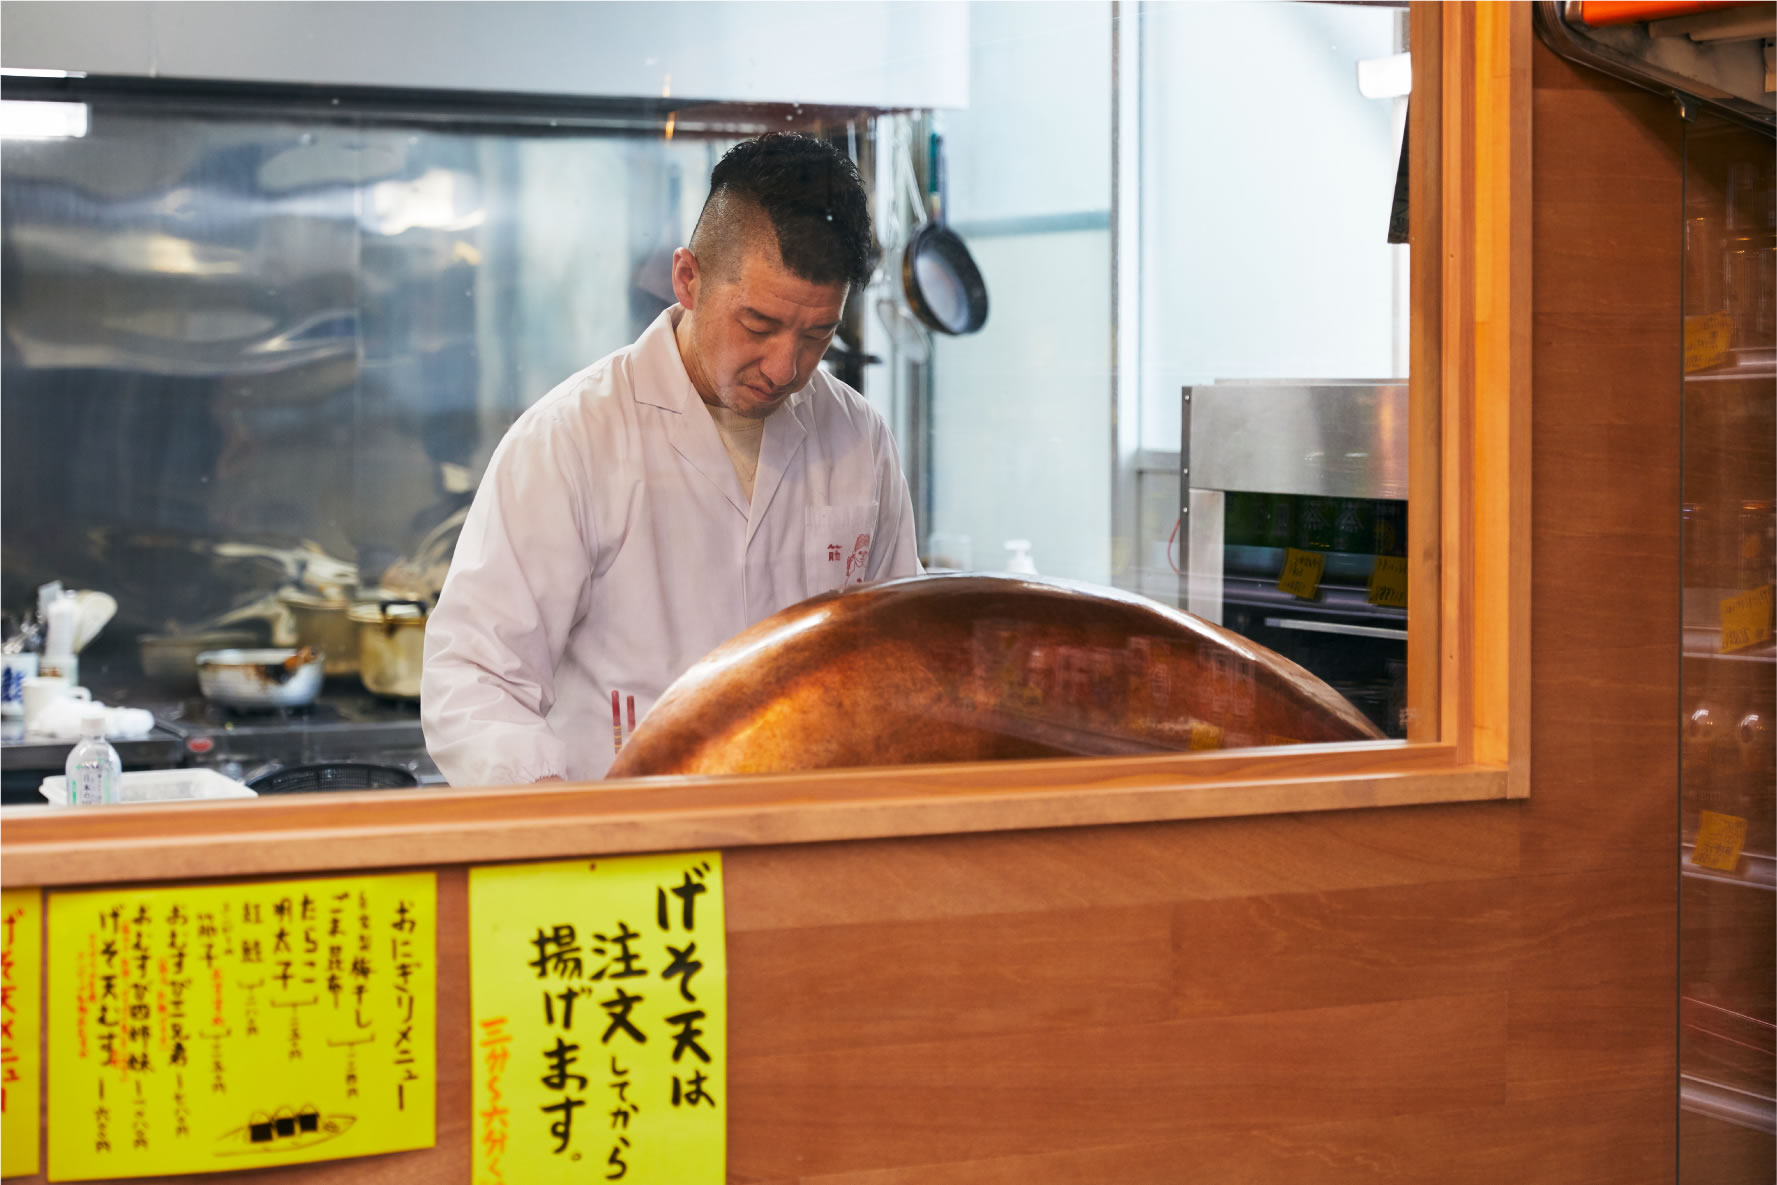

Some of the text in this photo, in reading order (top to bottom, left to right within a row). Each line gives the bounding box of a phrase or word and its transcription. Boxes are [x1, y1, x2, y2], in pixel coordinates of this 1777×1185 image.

[241, 902, 264, 964] 紅鮭
[272, 903, 294, 991] 明太子
[300, 895, 318, 984] たらこ
[326, 892, 350, 1009] ごま昆布
[391, 901, 422, 1111] おにぎりメニュー
[656, 861, 716, 1108] げそ天は
[527, 924, 593, 1161] 揚げます。
[589, 921, 649, 1181] 注文してから
